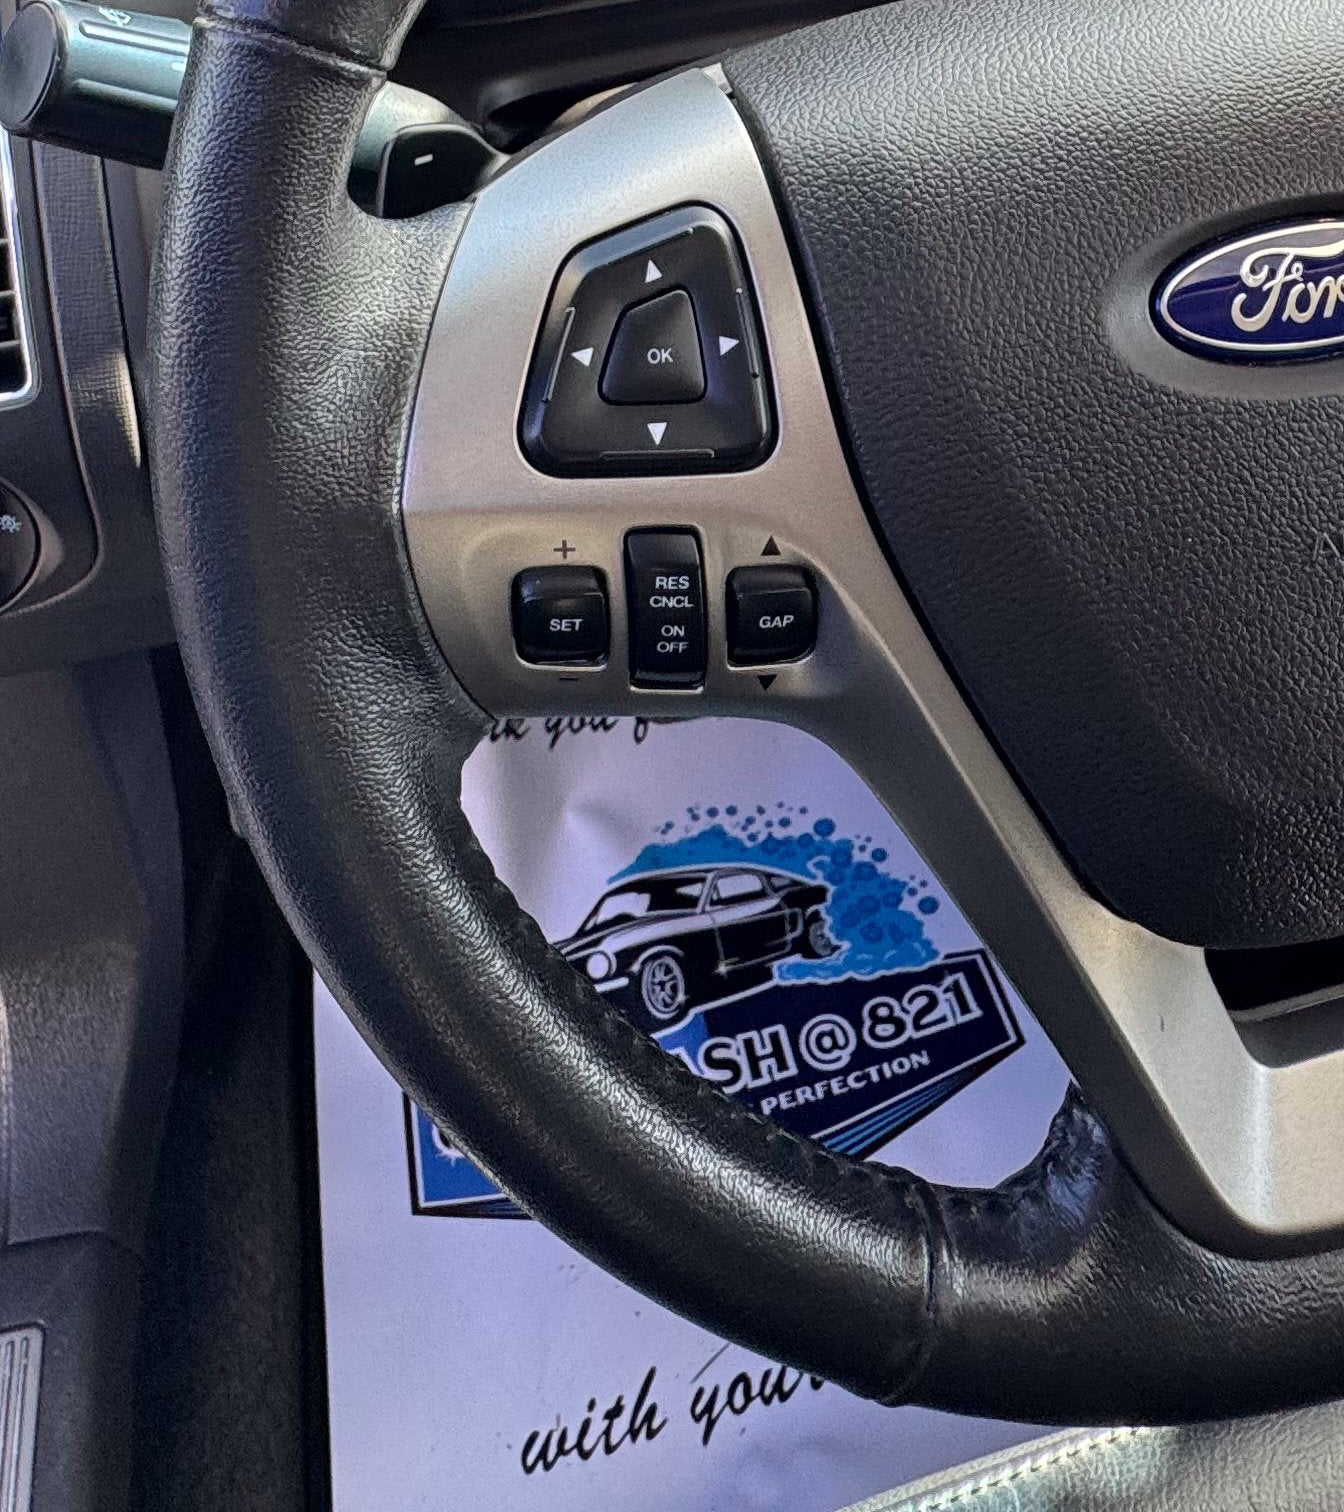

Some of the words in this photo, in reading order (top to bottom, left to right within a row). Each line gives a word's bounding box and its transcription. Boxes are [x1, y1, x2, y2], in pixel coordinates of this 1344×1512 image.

[646, 348, 673, 365] OK
[654, 575, 690, 590] RES
[649, 594, 694, 609] CNCL
[549, 617, 583, 633] SET
[759, 614, 794, 629] GAP
[660, 624, 685, 637] ON
[656, 640, 689, 654] OFF
[760, 1050, 931, 1116] PERFECTION
[521, 1366, 669, 1475] with
